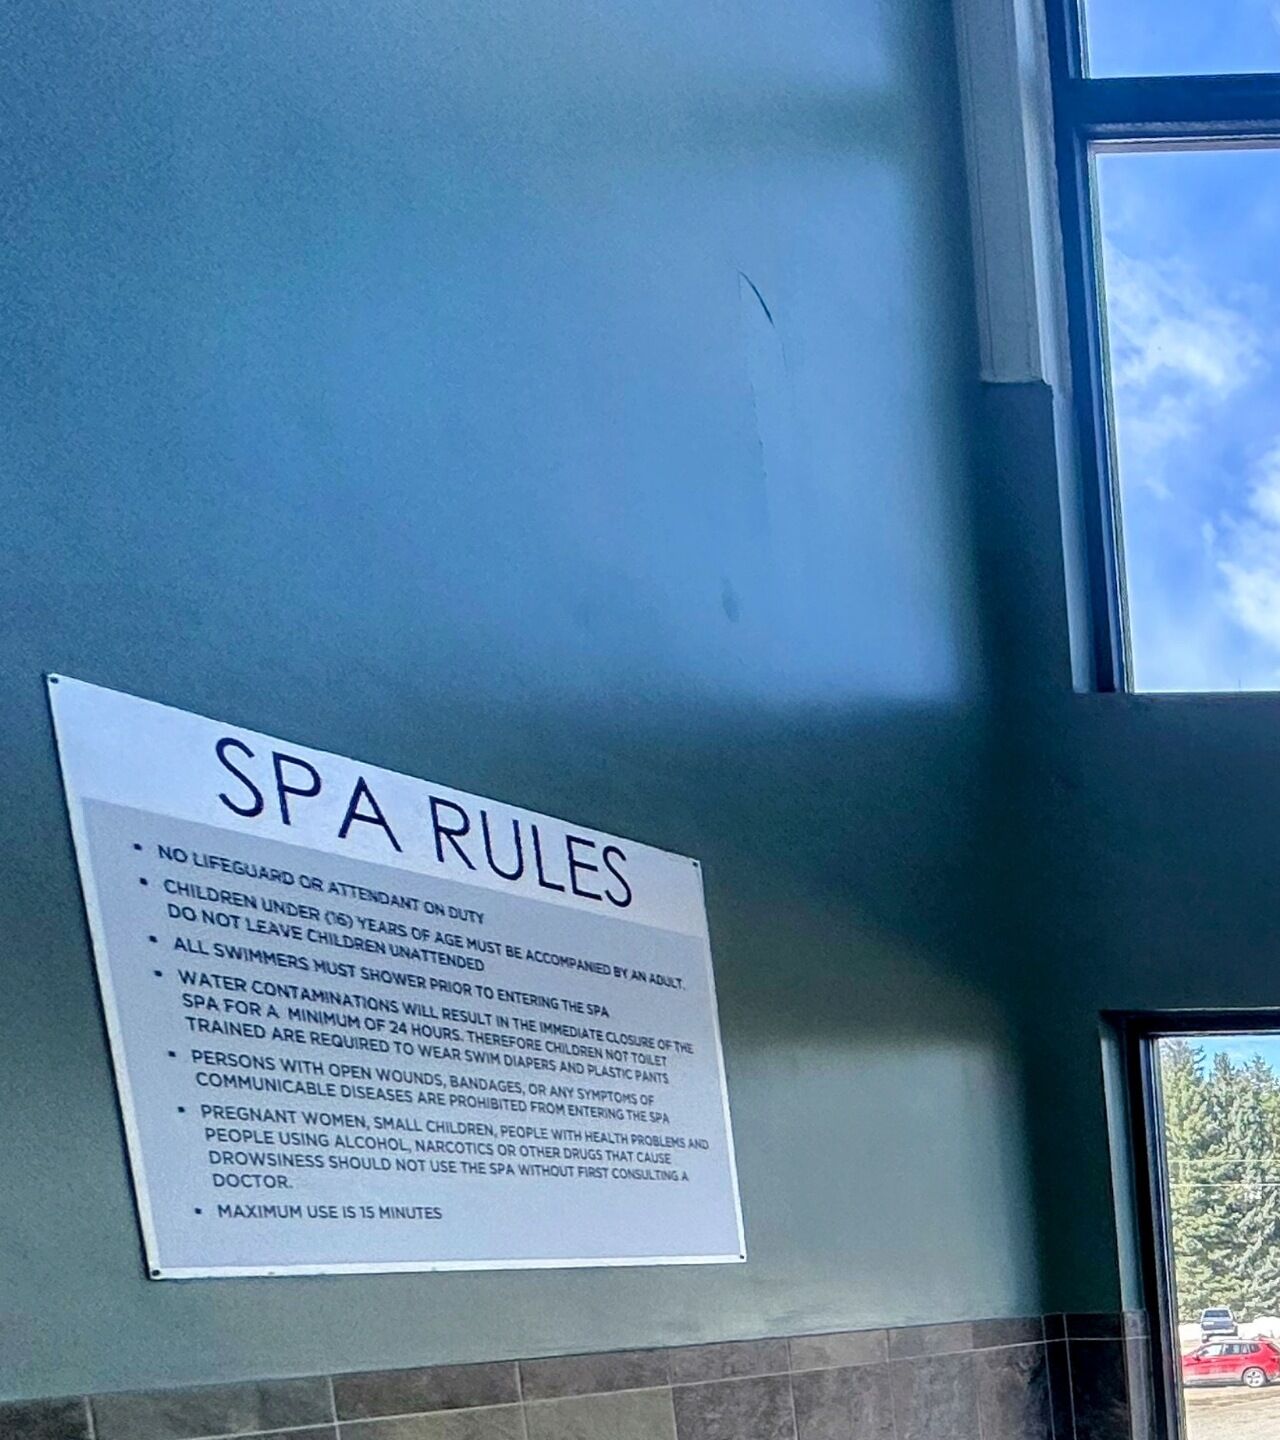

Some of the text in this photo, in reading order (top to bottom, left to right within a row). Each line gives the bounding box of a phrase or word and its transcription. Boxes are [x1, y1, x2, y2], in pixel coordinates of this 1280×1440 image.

[216, 738, 631, 907] SPA RULES
[157, 844, 484, 924] NO LIFEGUARD OR ATTENDANT ON DUTY
[163, 878, 686, 991] CHILDREN UNDER (16) YEARS OF AGE MUST BE ACCOMPANIED BY AN ADULT.
[167, 902, 484, 971] DO NOT LEAVE CHILDREN UNATTENDED
[173, 936, 610, 1018] ALL SWIMMERS MUST SHOWER PRIOR TO ENTERING THE SPA
[177, 968, 694, 1054] WATER CONTAMINATIONS WILL RESULT IN THE IMMEDIATE CLOSURE OF THE
[182, 992, 666, 1066] SPA FOR A MINIMUM OF 24 HOURS. THEREFORE CHILDREN NOT TOILET
[185, 1015, 669, 1084] TRAINED ARE REQUIRED TO WEAR SWIM DIAPERS AND PLASTIC PANTS
[191, 1049, 654, 1105] PERSONS WITH OPEN WOUNDS, BANDAGES, OR ANY SYMPTOMS OF
[195, 1071, 670, 1124] COMMUNICABLE DISEASES ARE PROHIBITED FROM ENTERING THE SPA
[201, 1104, 709, 1150] PREGNANT WOMEN, SMALL CHILDREN, PEOPLE WITH HEALTH PROBLEMS AND
[205, 1127, 671, 1164] PEOPLE USING ALCOHOL, NARCOTICS OR OTHER DRUGS THAT CAUSE
[209, 1149, 689, 1181] DROWSINESS SHOULD NOT USE THE SPA WITHOUT FIRST CONSULTING A
[212, 1172, 293, 1188] DOCTOR.
[217, 1204, 442, 1219] MAXIMUM USE IS 15 MINUTES
